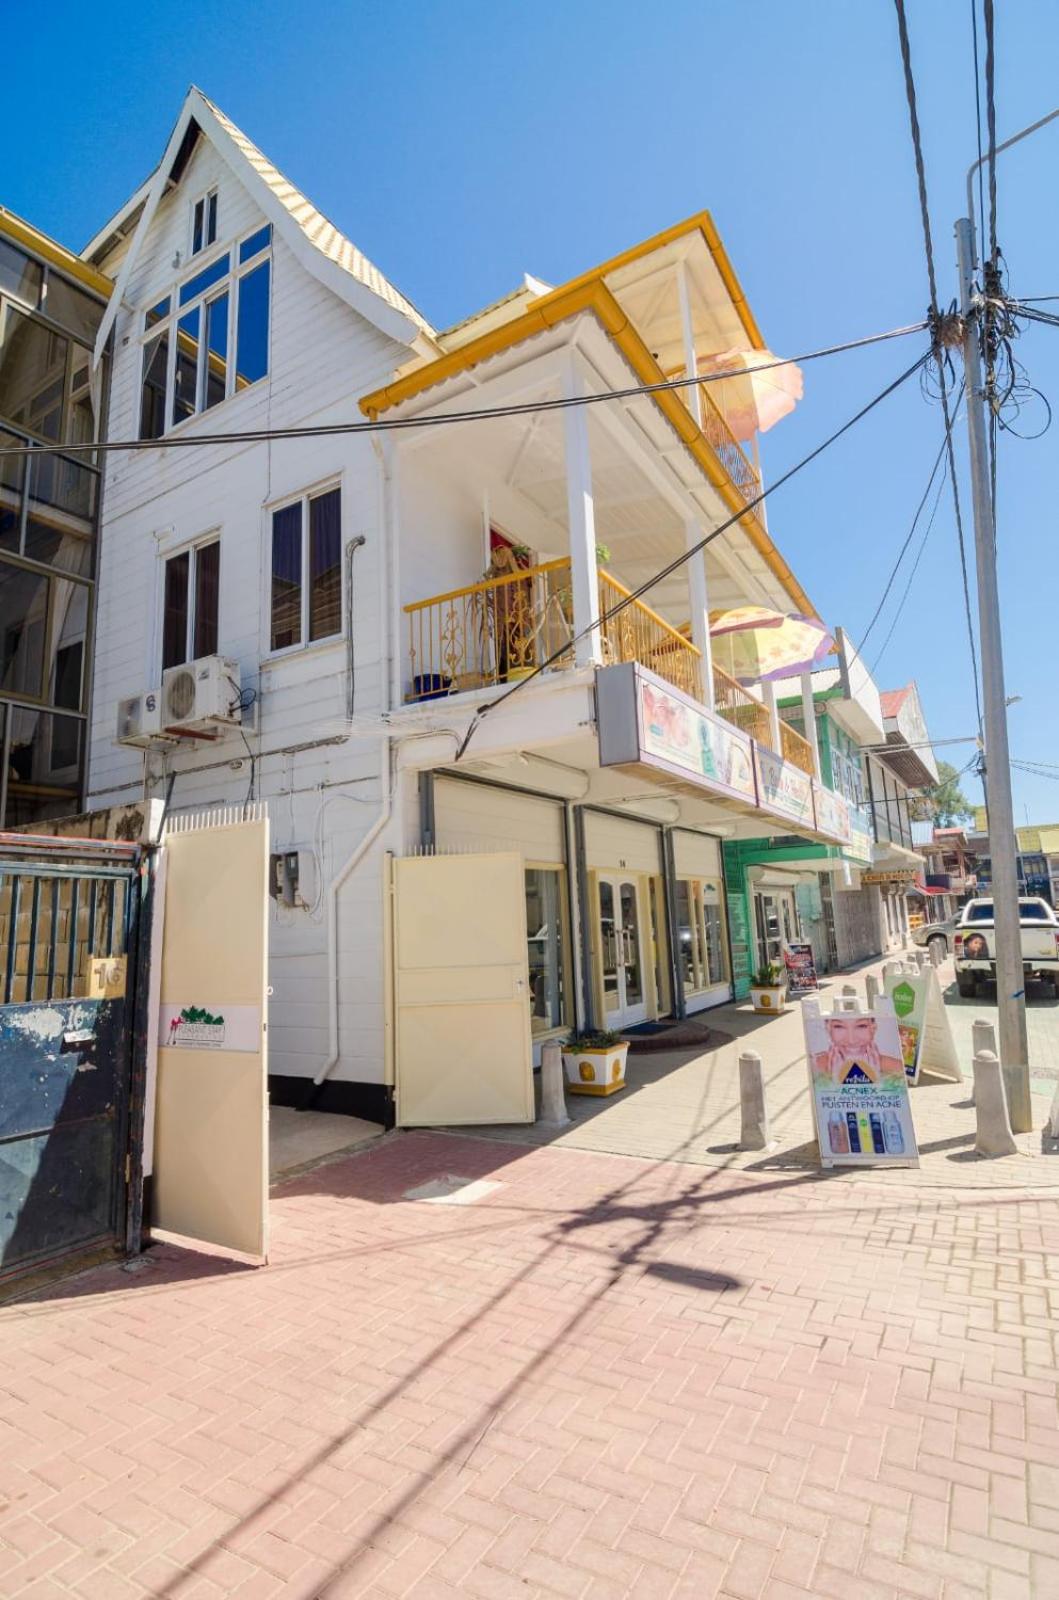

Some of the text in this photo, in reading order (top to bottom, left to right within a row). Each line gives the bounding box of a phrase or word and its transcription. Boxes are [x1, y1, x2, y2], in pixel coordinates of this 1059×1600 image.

[95, 962, 121, 989] 16
[840, 1087, 879, 1095] ACNEX
[822, 1101, 859, 1109] PUISTEN
[861, 1101, 874, 1109] EN
